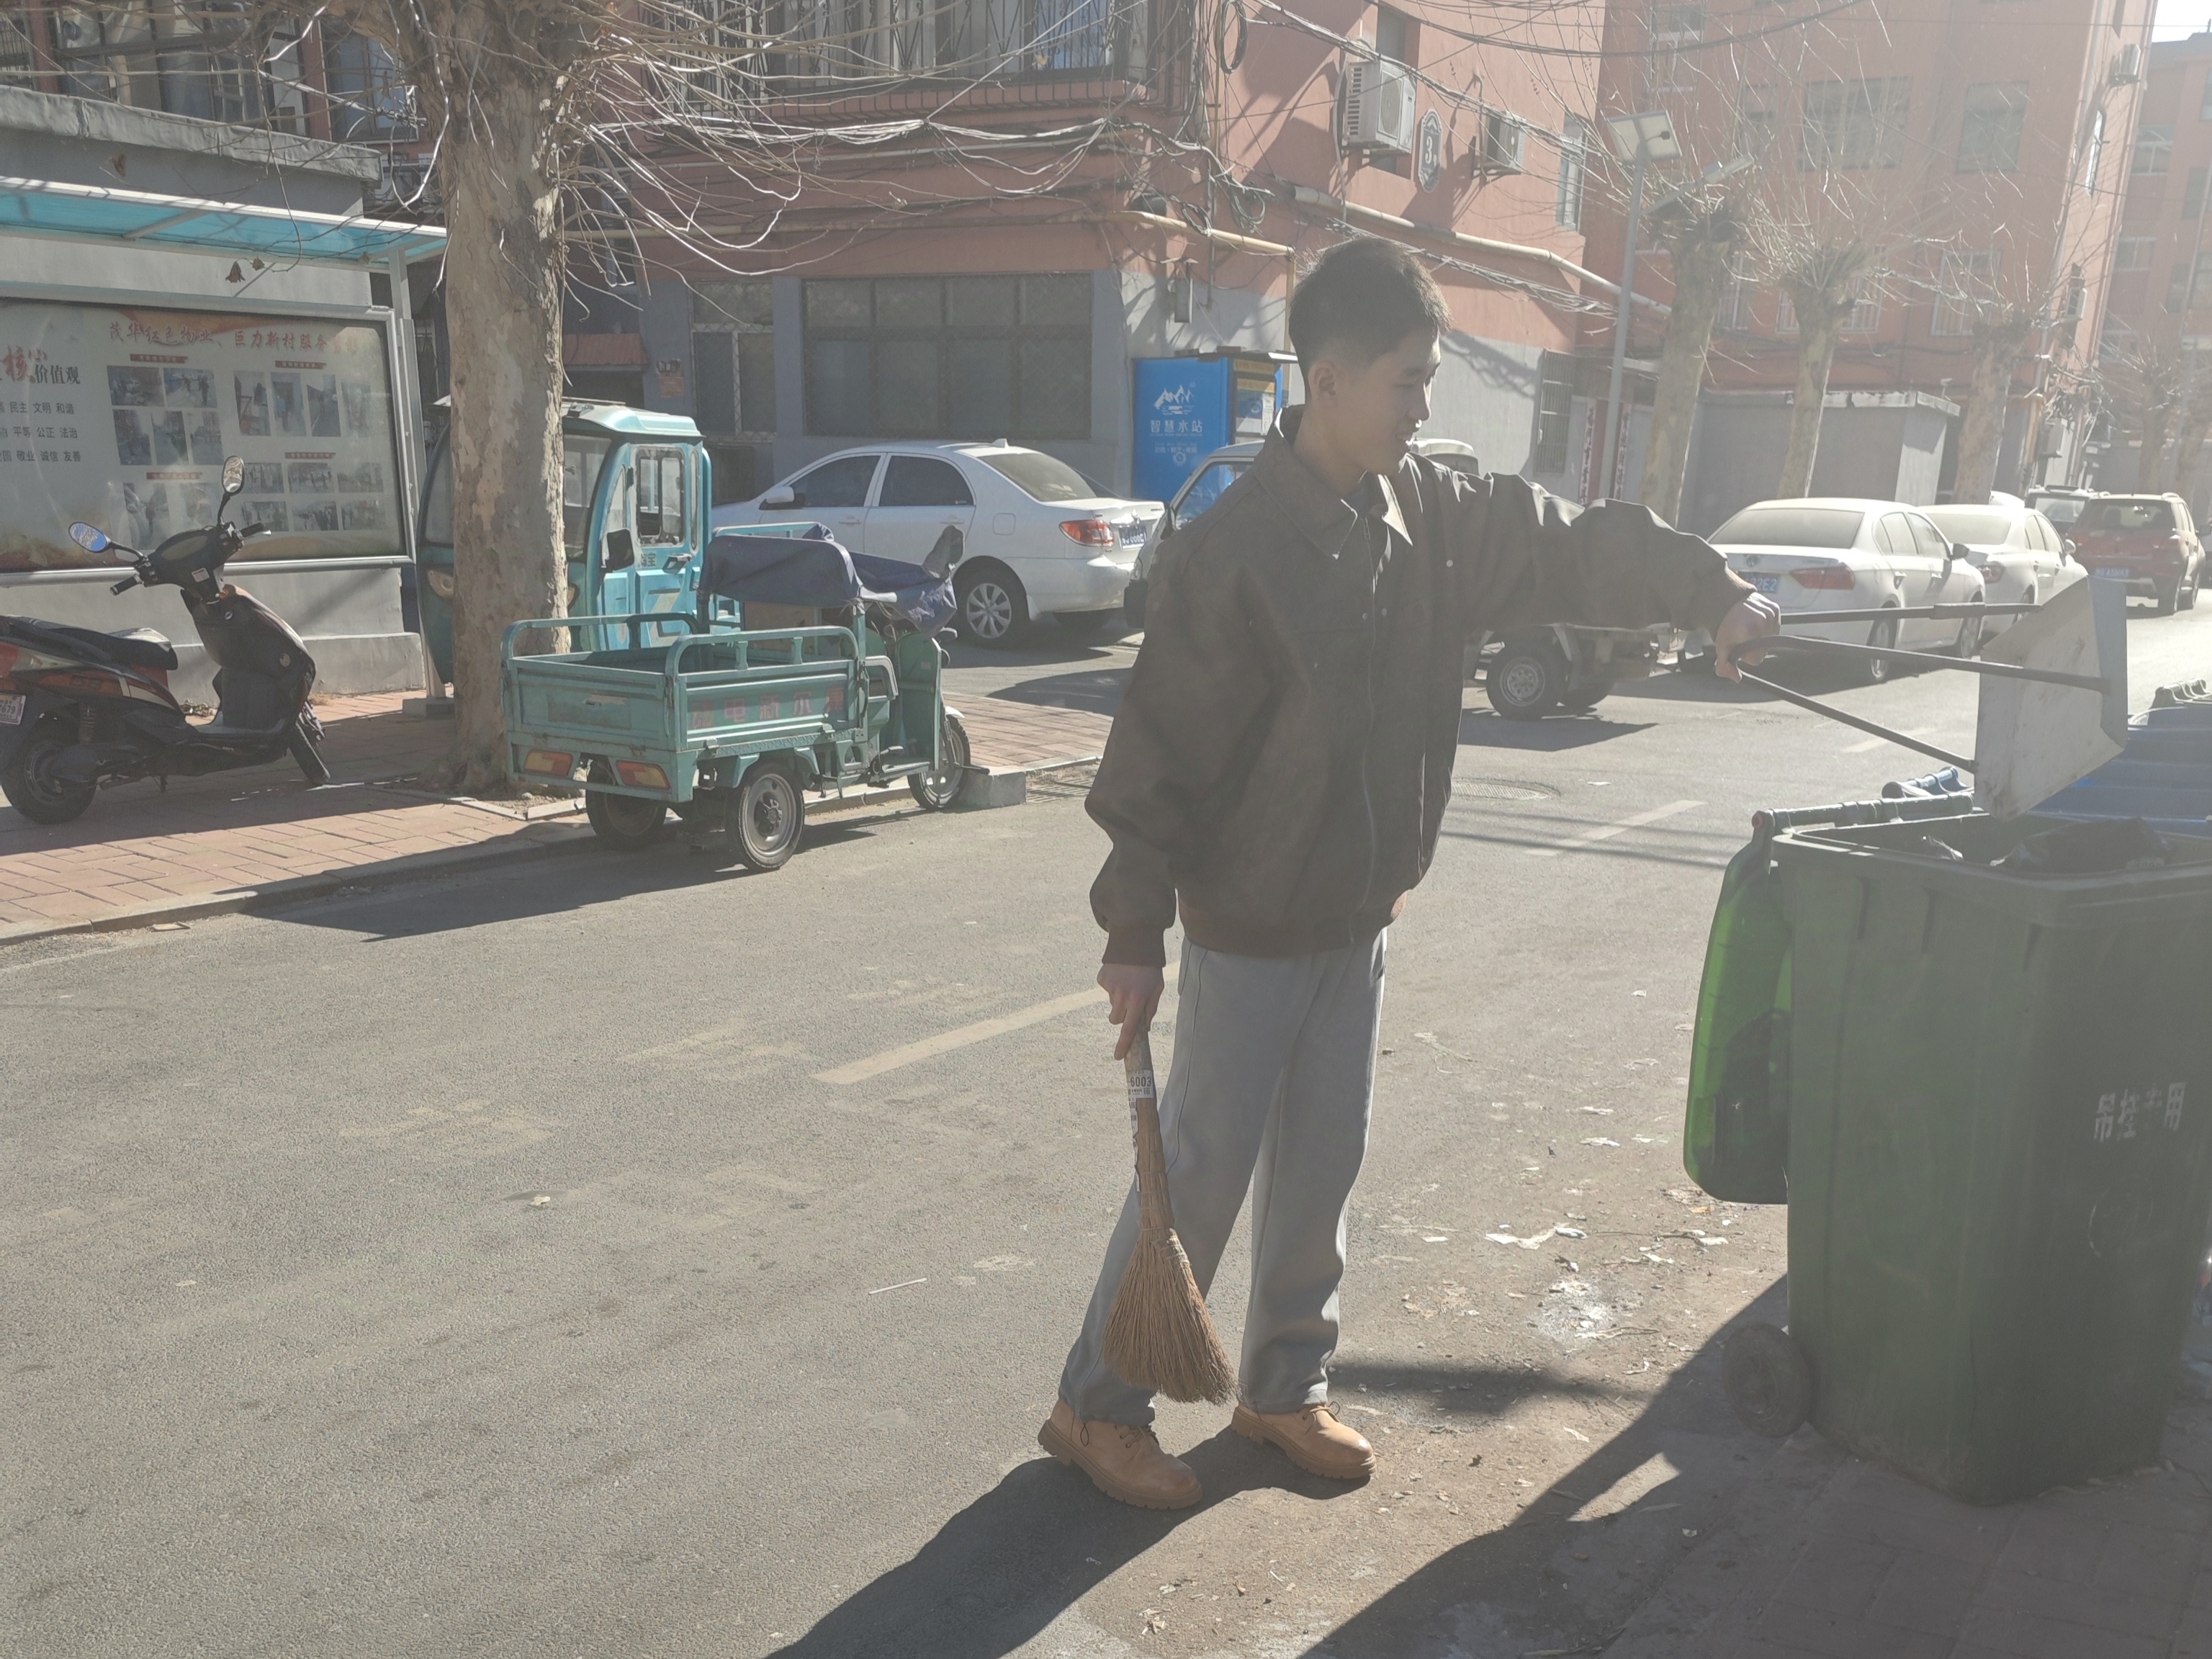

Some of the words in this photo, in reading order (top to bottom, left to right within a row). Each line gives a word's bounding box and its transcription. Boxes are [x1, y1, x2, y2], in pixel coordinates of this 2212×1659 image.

[9, 402, 28, 413] 民主
[33, 403, 51, 414] 文明
[56, 403, 74, 415] 和谐
[13, 426, 31, 438] 平等
[37, 427, 55, 439] 公正
[60, 427, 78, 439] 法治
[1150, 420, 1203, 433] 智慧水站
[17, 450, 35, 462] 敬业
[40, 451, 58, 462] 诚信
[63, 451, 81, 462] 友善
